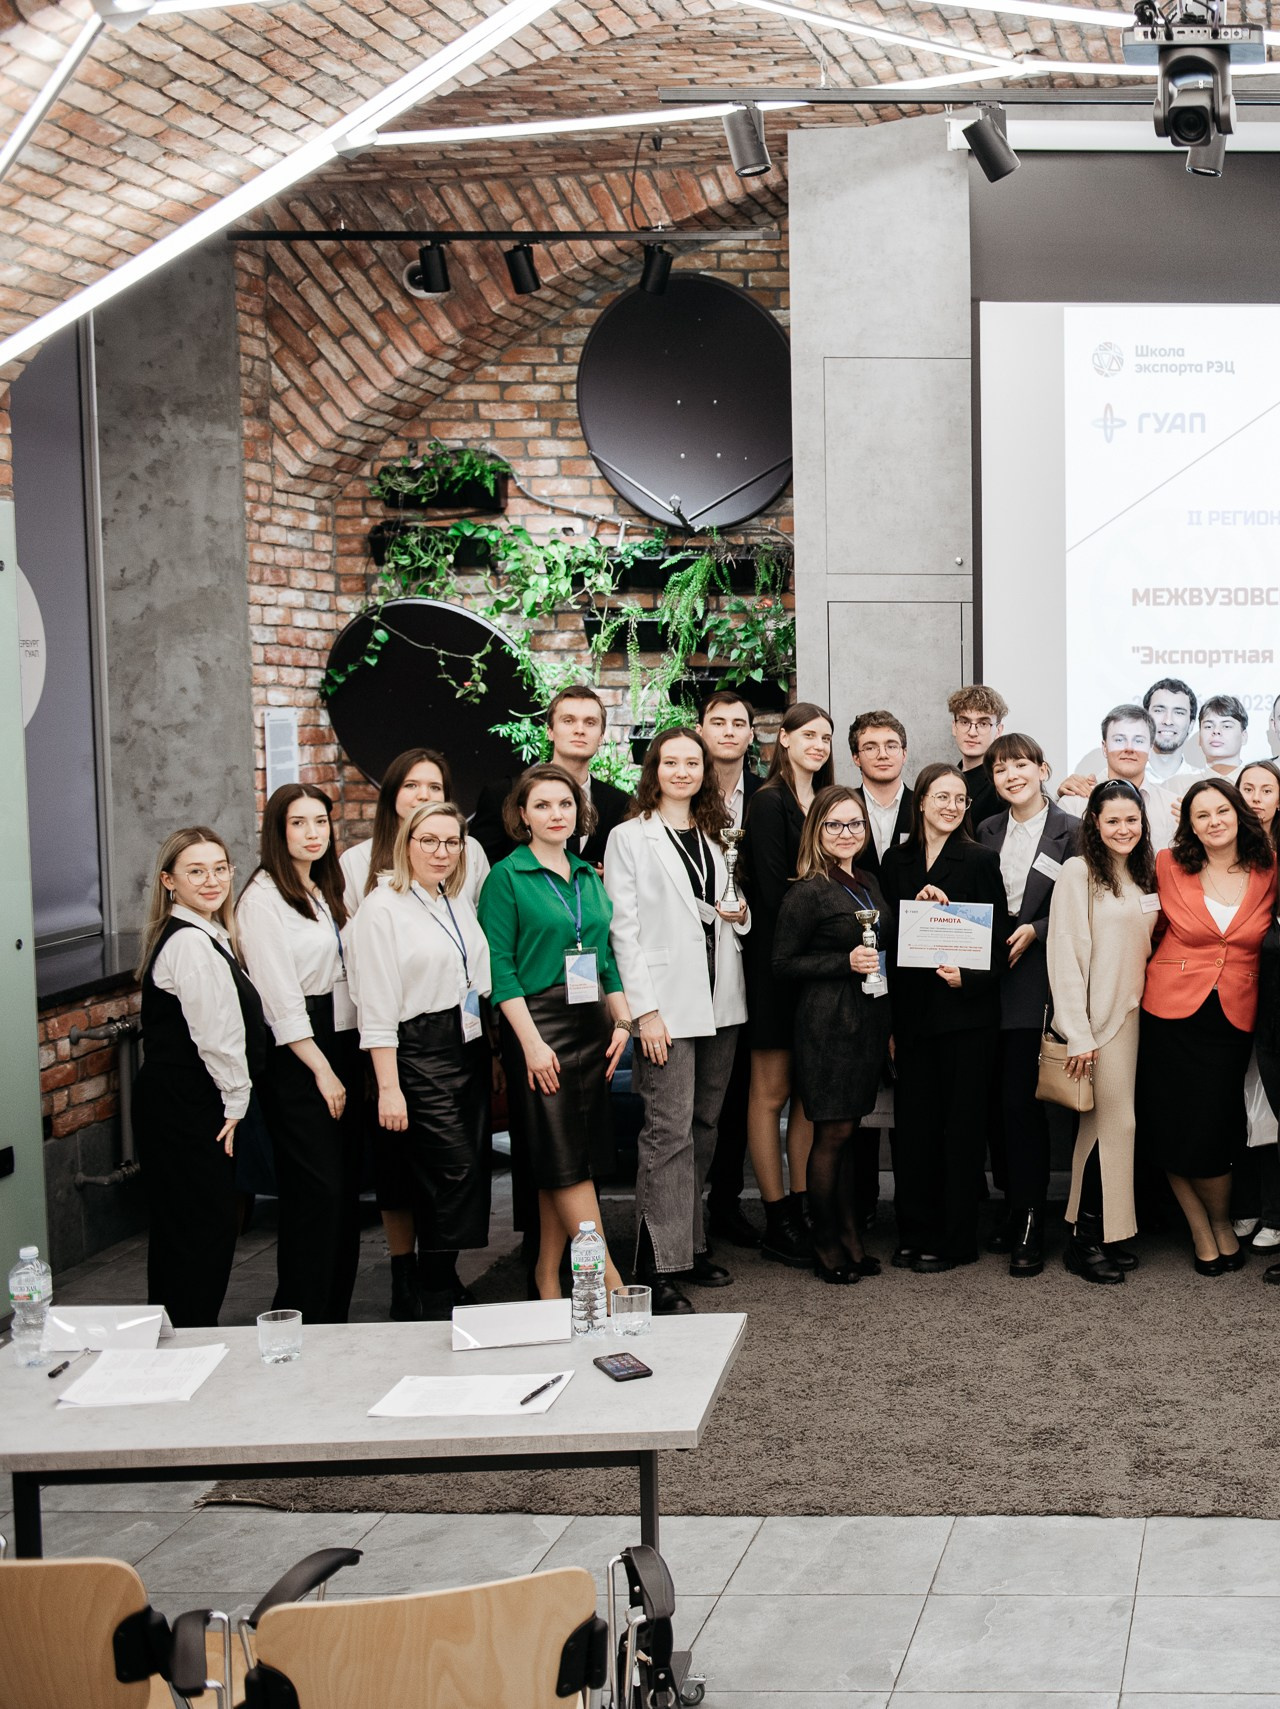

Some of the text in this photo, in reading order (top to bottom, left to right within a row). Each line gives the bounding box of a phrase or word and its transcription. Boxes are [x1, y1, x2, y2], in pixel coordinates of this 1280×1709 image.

[1134, 344, 1186, 358] Школа
[1134, 359, 1236, 376] экспорта РЭЦ
[1137, 411, 1206, 434] ГУАП
[1187, 509, 1203, 526] II
[1131, 646, 1274, 669] "Экспортная
